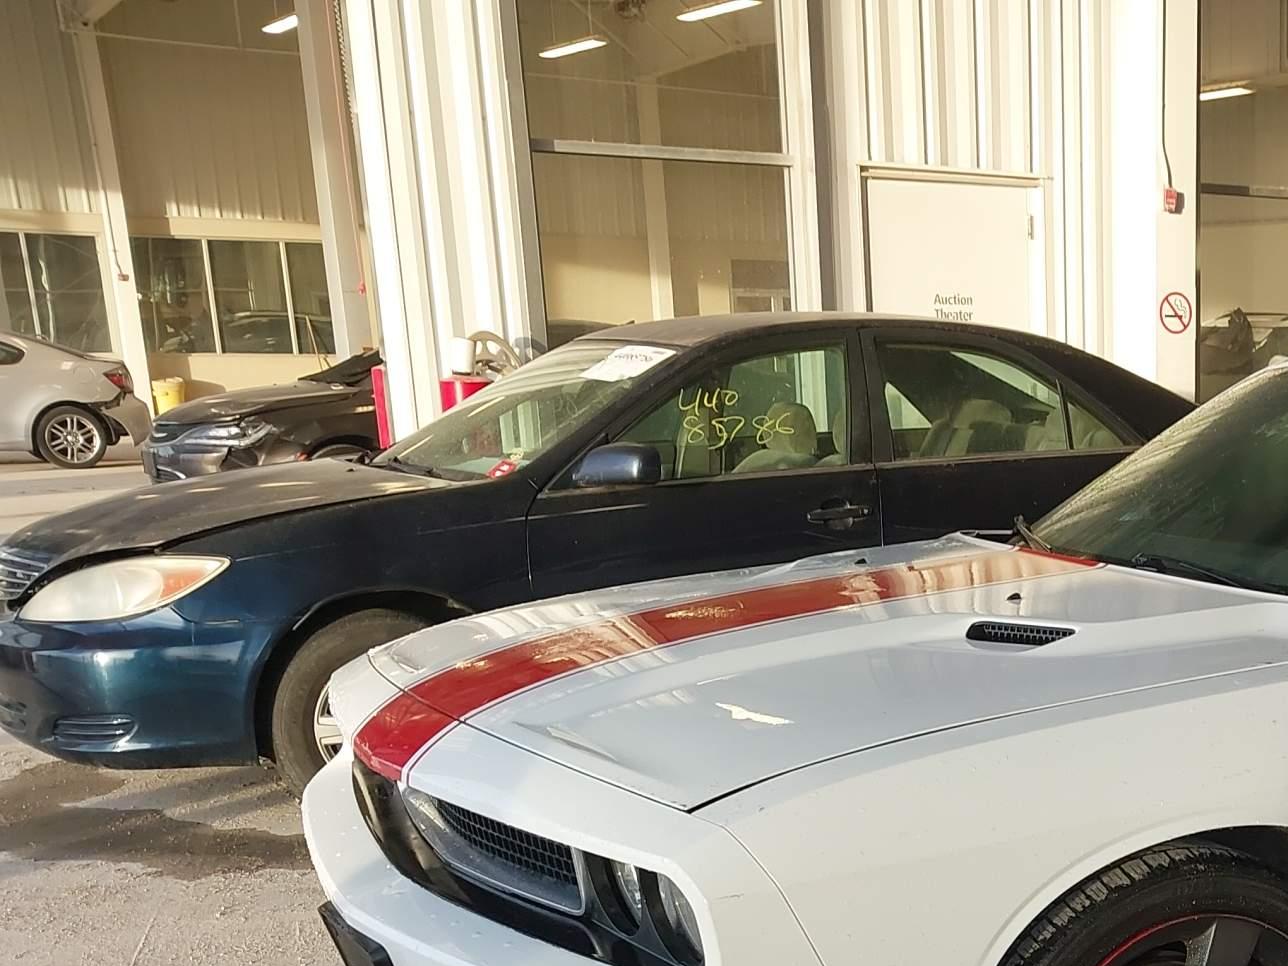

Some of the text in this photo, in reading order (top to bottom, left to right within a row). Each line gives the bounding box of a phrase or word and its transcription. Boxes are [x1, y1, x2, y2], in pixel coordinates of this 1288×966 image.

[934, 293, 973, 306] Auction
[934, 308, 973, 321] Theater
[679, 387, 739, 417] 440
